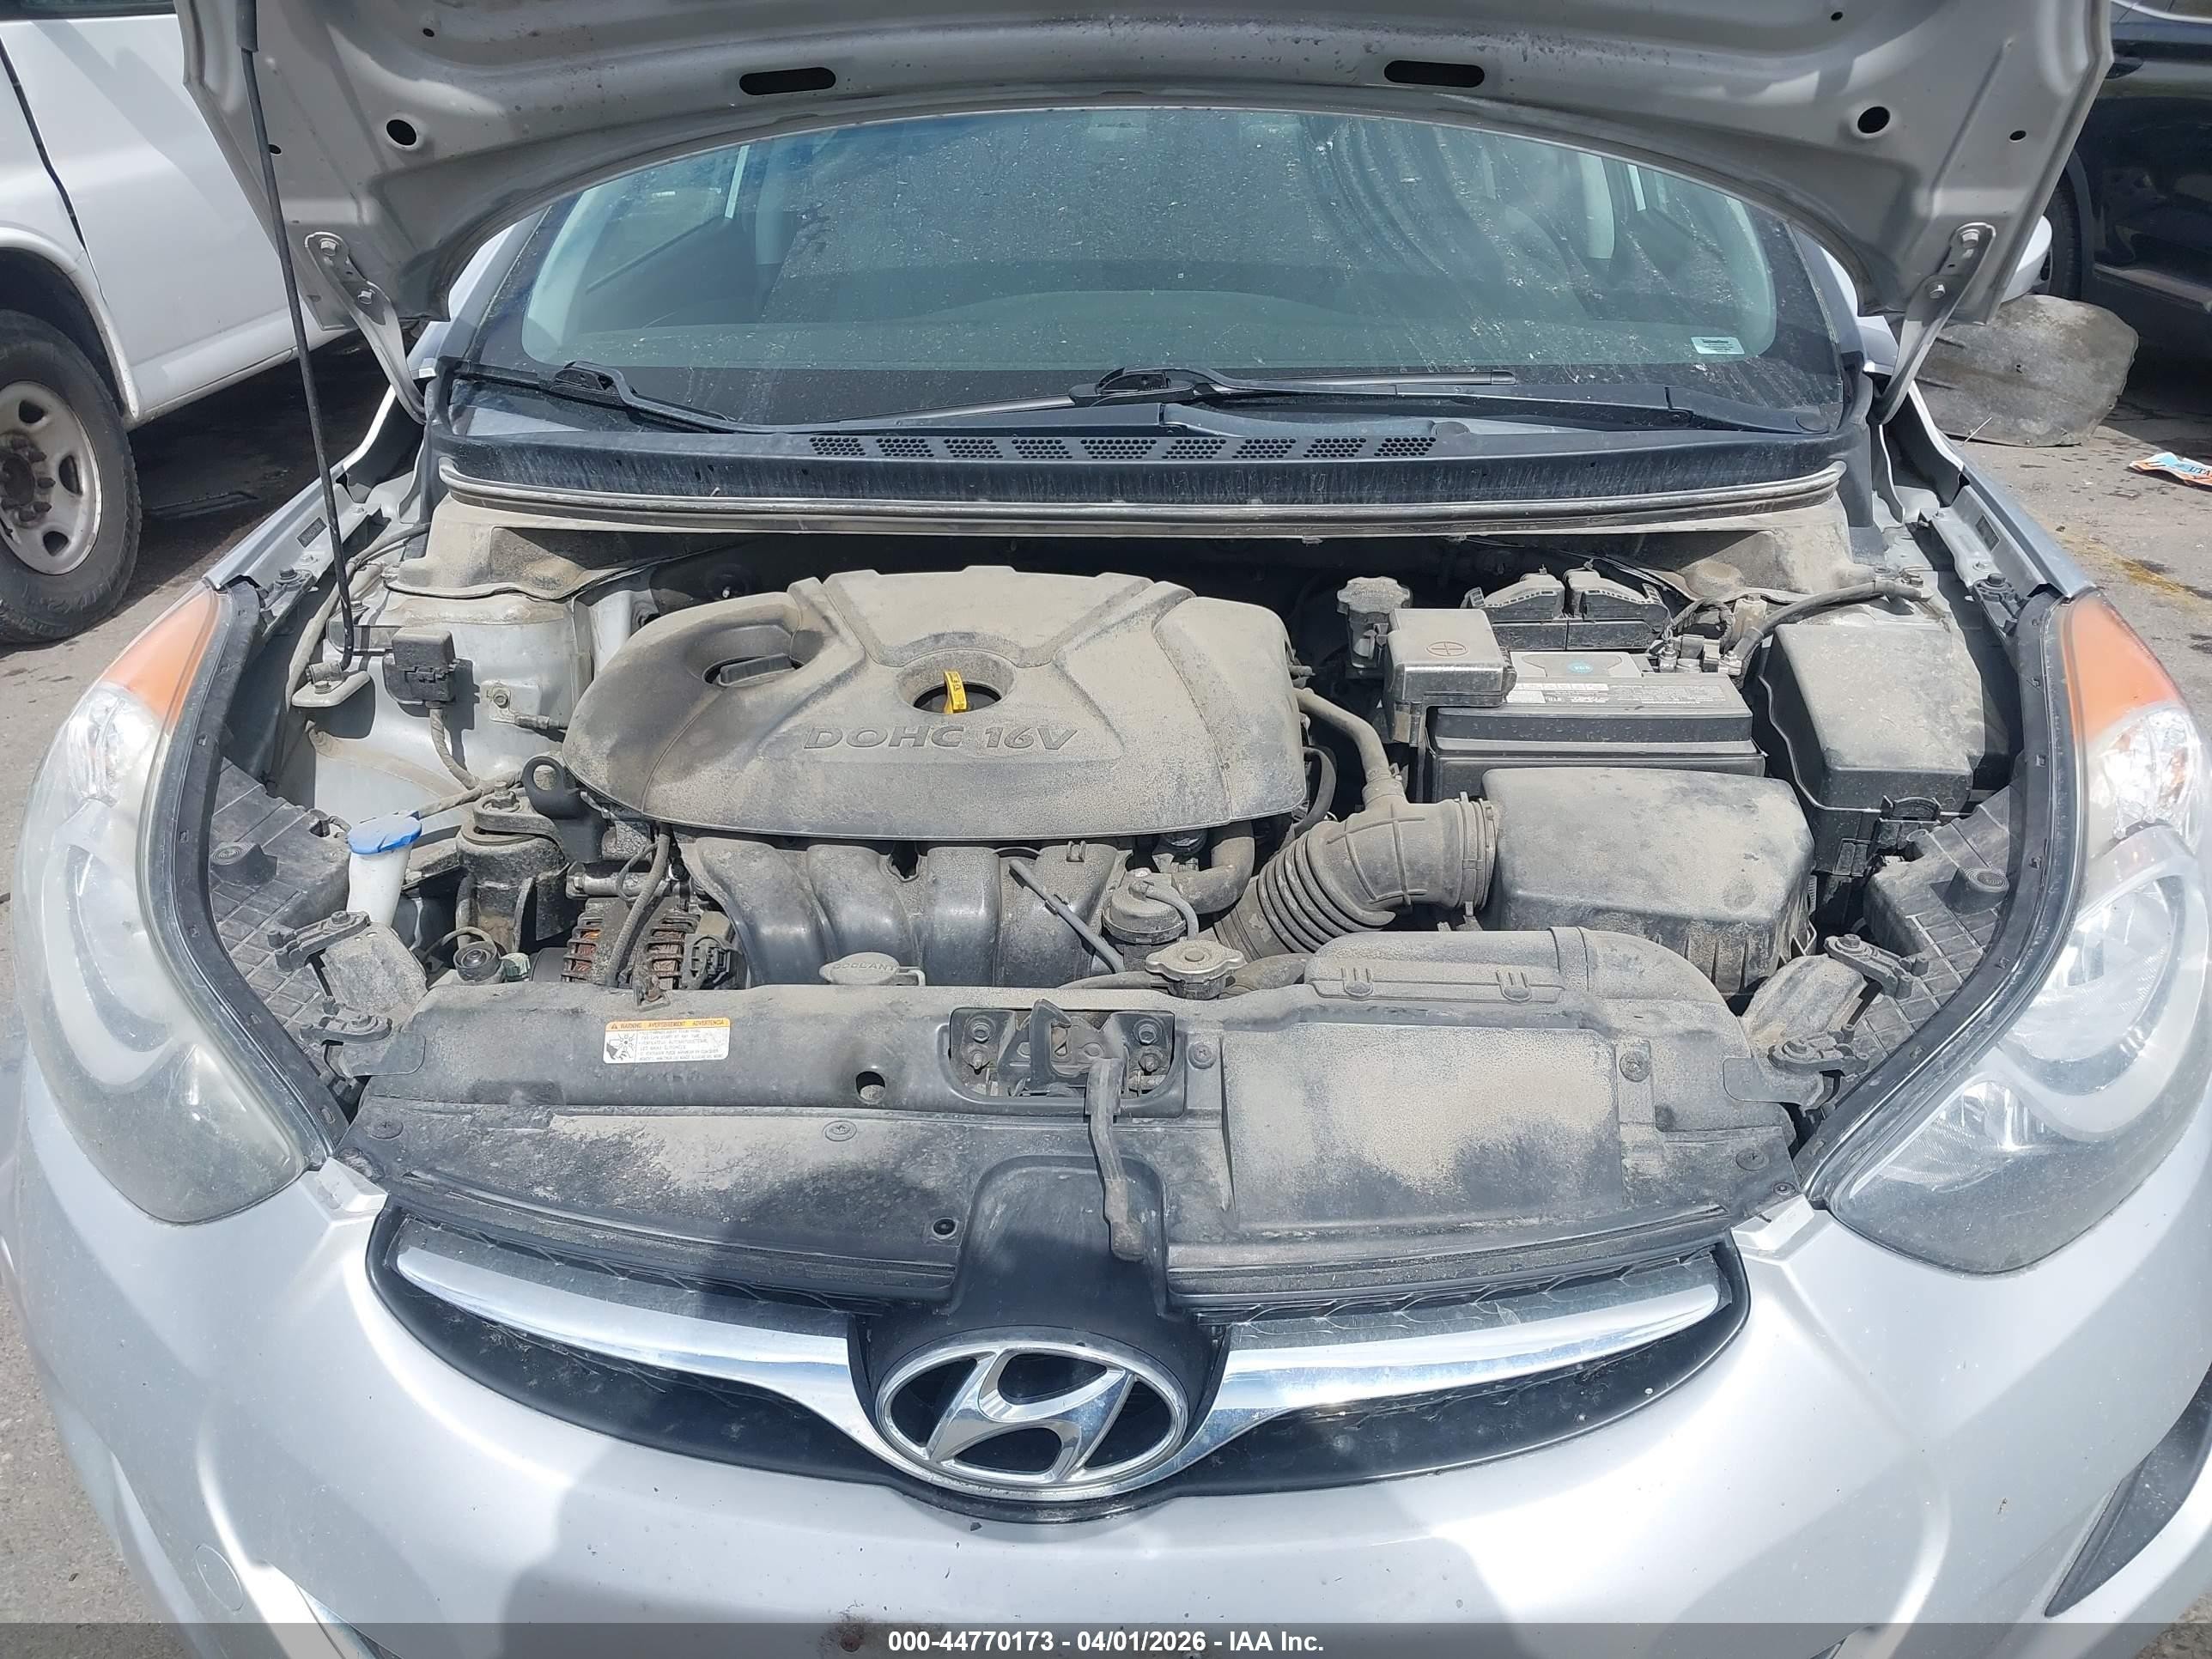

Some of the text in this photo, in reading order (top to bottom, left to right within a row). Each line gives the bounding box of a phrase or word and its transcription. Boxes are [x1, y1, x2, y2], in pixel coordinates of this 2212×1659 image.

[804, 726, 1079, 750] DOHC 16V
[832, 962, 896, 971] COOLANT
